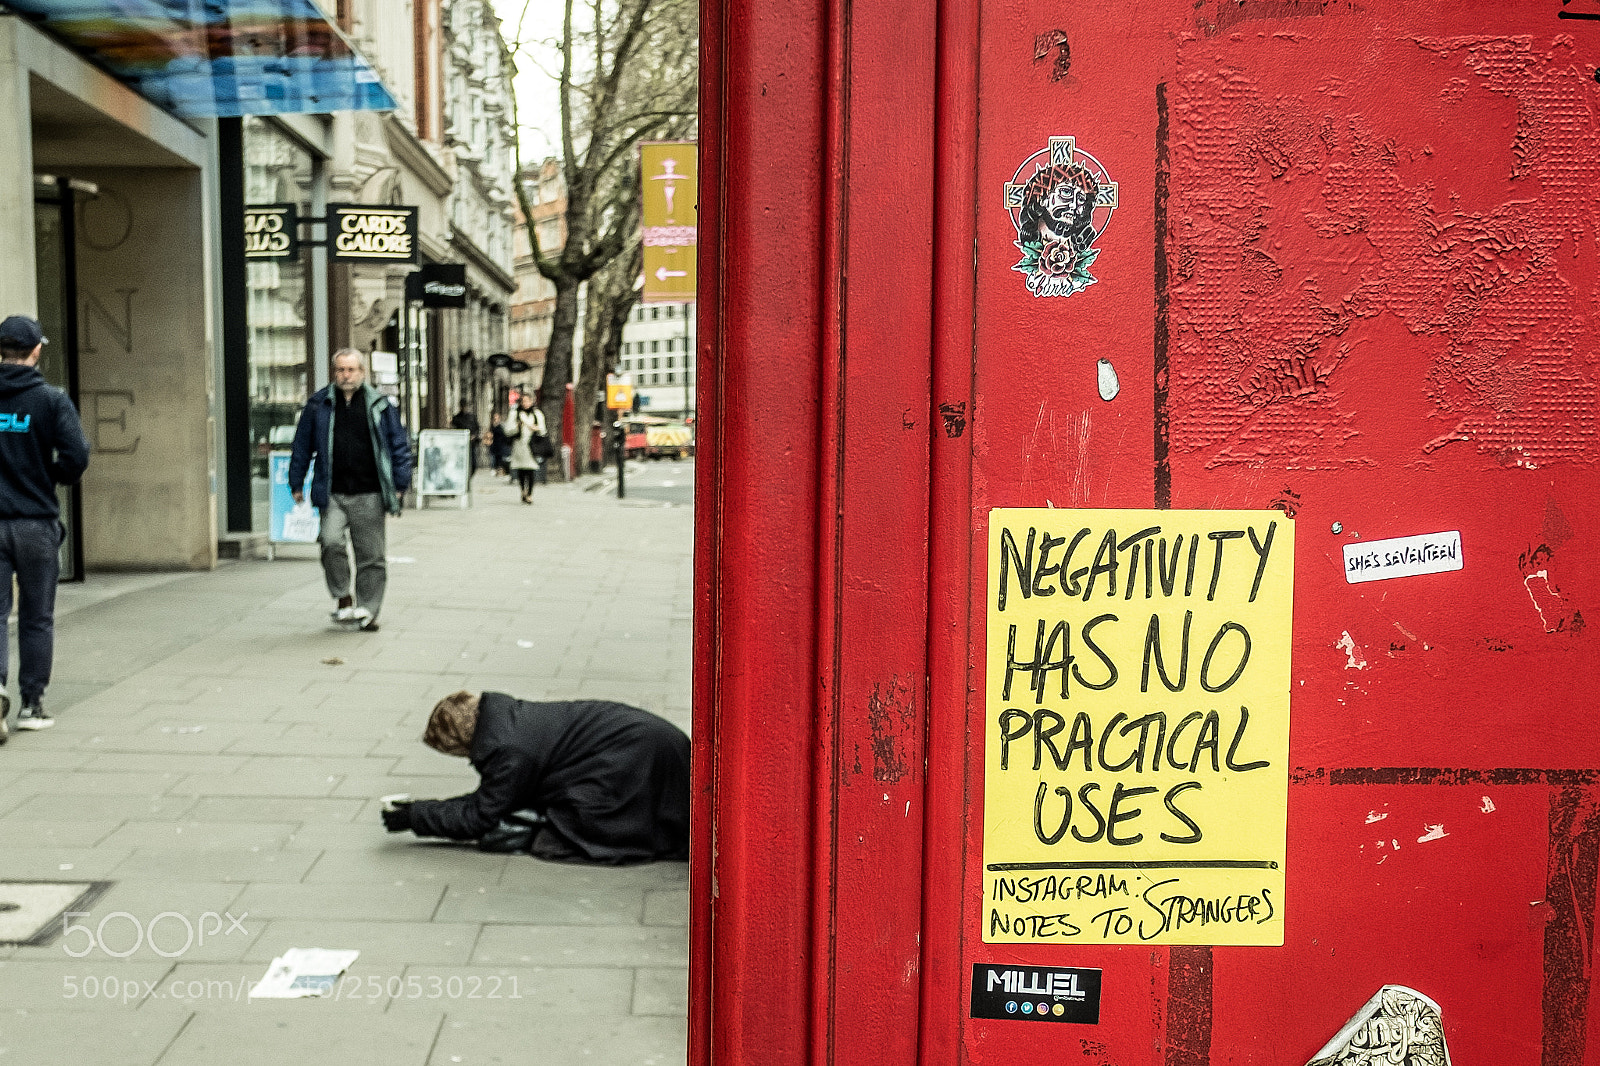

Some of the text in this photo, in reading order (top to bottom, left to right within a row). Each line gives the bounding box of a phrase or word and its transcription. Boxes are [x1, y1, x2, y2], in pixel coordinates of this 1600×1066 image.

[335, 233, 412, 253] GALORE
[340, 215, 407, 234] CARDS
[998, 521, 1277, 611] NEGATIVITY
[1383, 538, 1457, 567] SEVENTEEN
[1002, 610, 1251, 704] HAS NO
[998, 706, 1270, 773] PRACTICAL
[1033, 782, 1203, 846] USES
[990, 878, 1274, 940] NOTES TO STRANGERS
